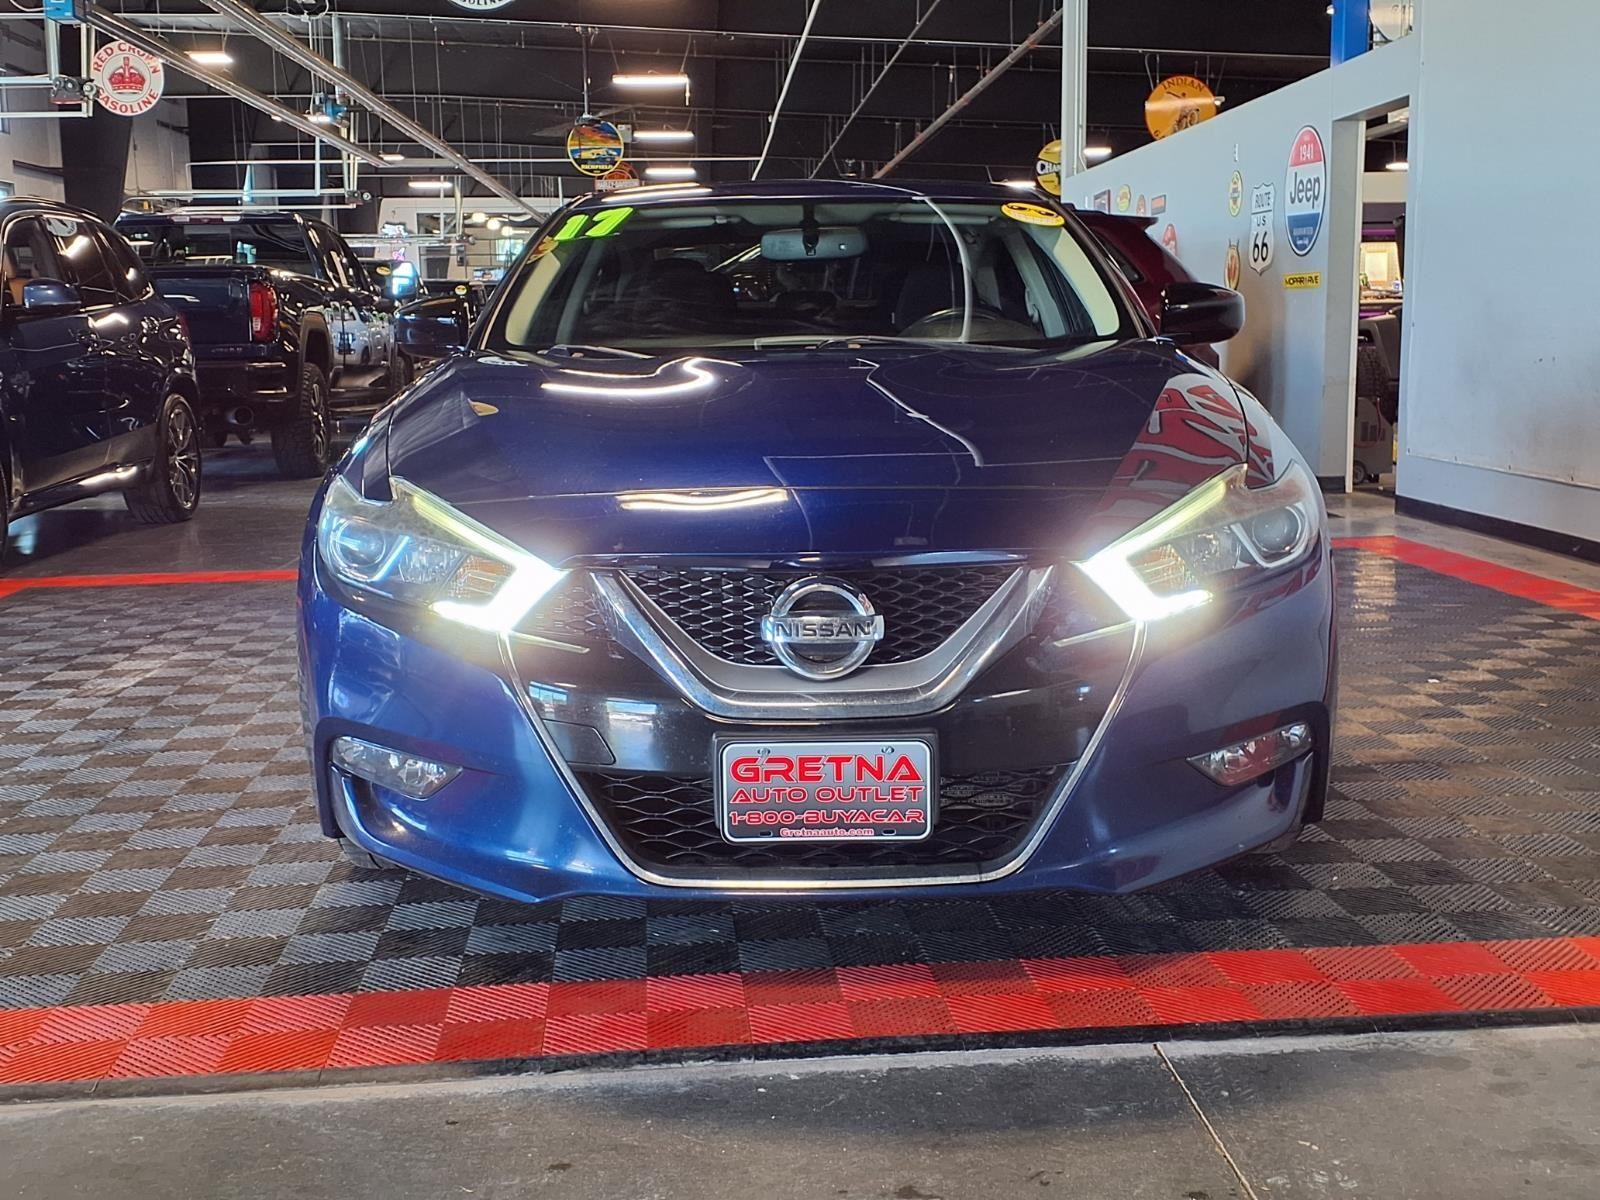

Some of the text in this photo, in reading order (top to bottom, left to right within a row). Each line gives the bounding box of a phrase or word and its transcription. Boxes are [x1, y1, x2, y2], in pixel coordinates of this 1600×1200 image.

[93, 47, 114, 73] RED
[1162, 77, 1204, 92] INDIAN
[97, 86, 159, 114] GASOLINE
[1300, 143, 1314, 160] 1941
[1289, 171, 1321, 209] Jeep
[1255, 191, 1271, 209] ROUTE
[554, 207, 633, 240] 17
[1256, 215, 1266, 227] US
[1252, 231, 1269, 263] 66
[775, 621, 873, 638] NISSAN
[730, 753, 924, 784] GRETNA
[729, 785, 925, 804] AUTO OUTLET
[729, 809, 925, 825] 1-800-BUYACAR
[779, 827, 874, 837] Gretnaauto.com
